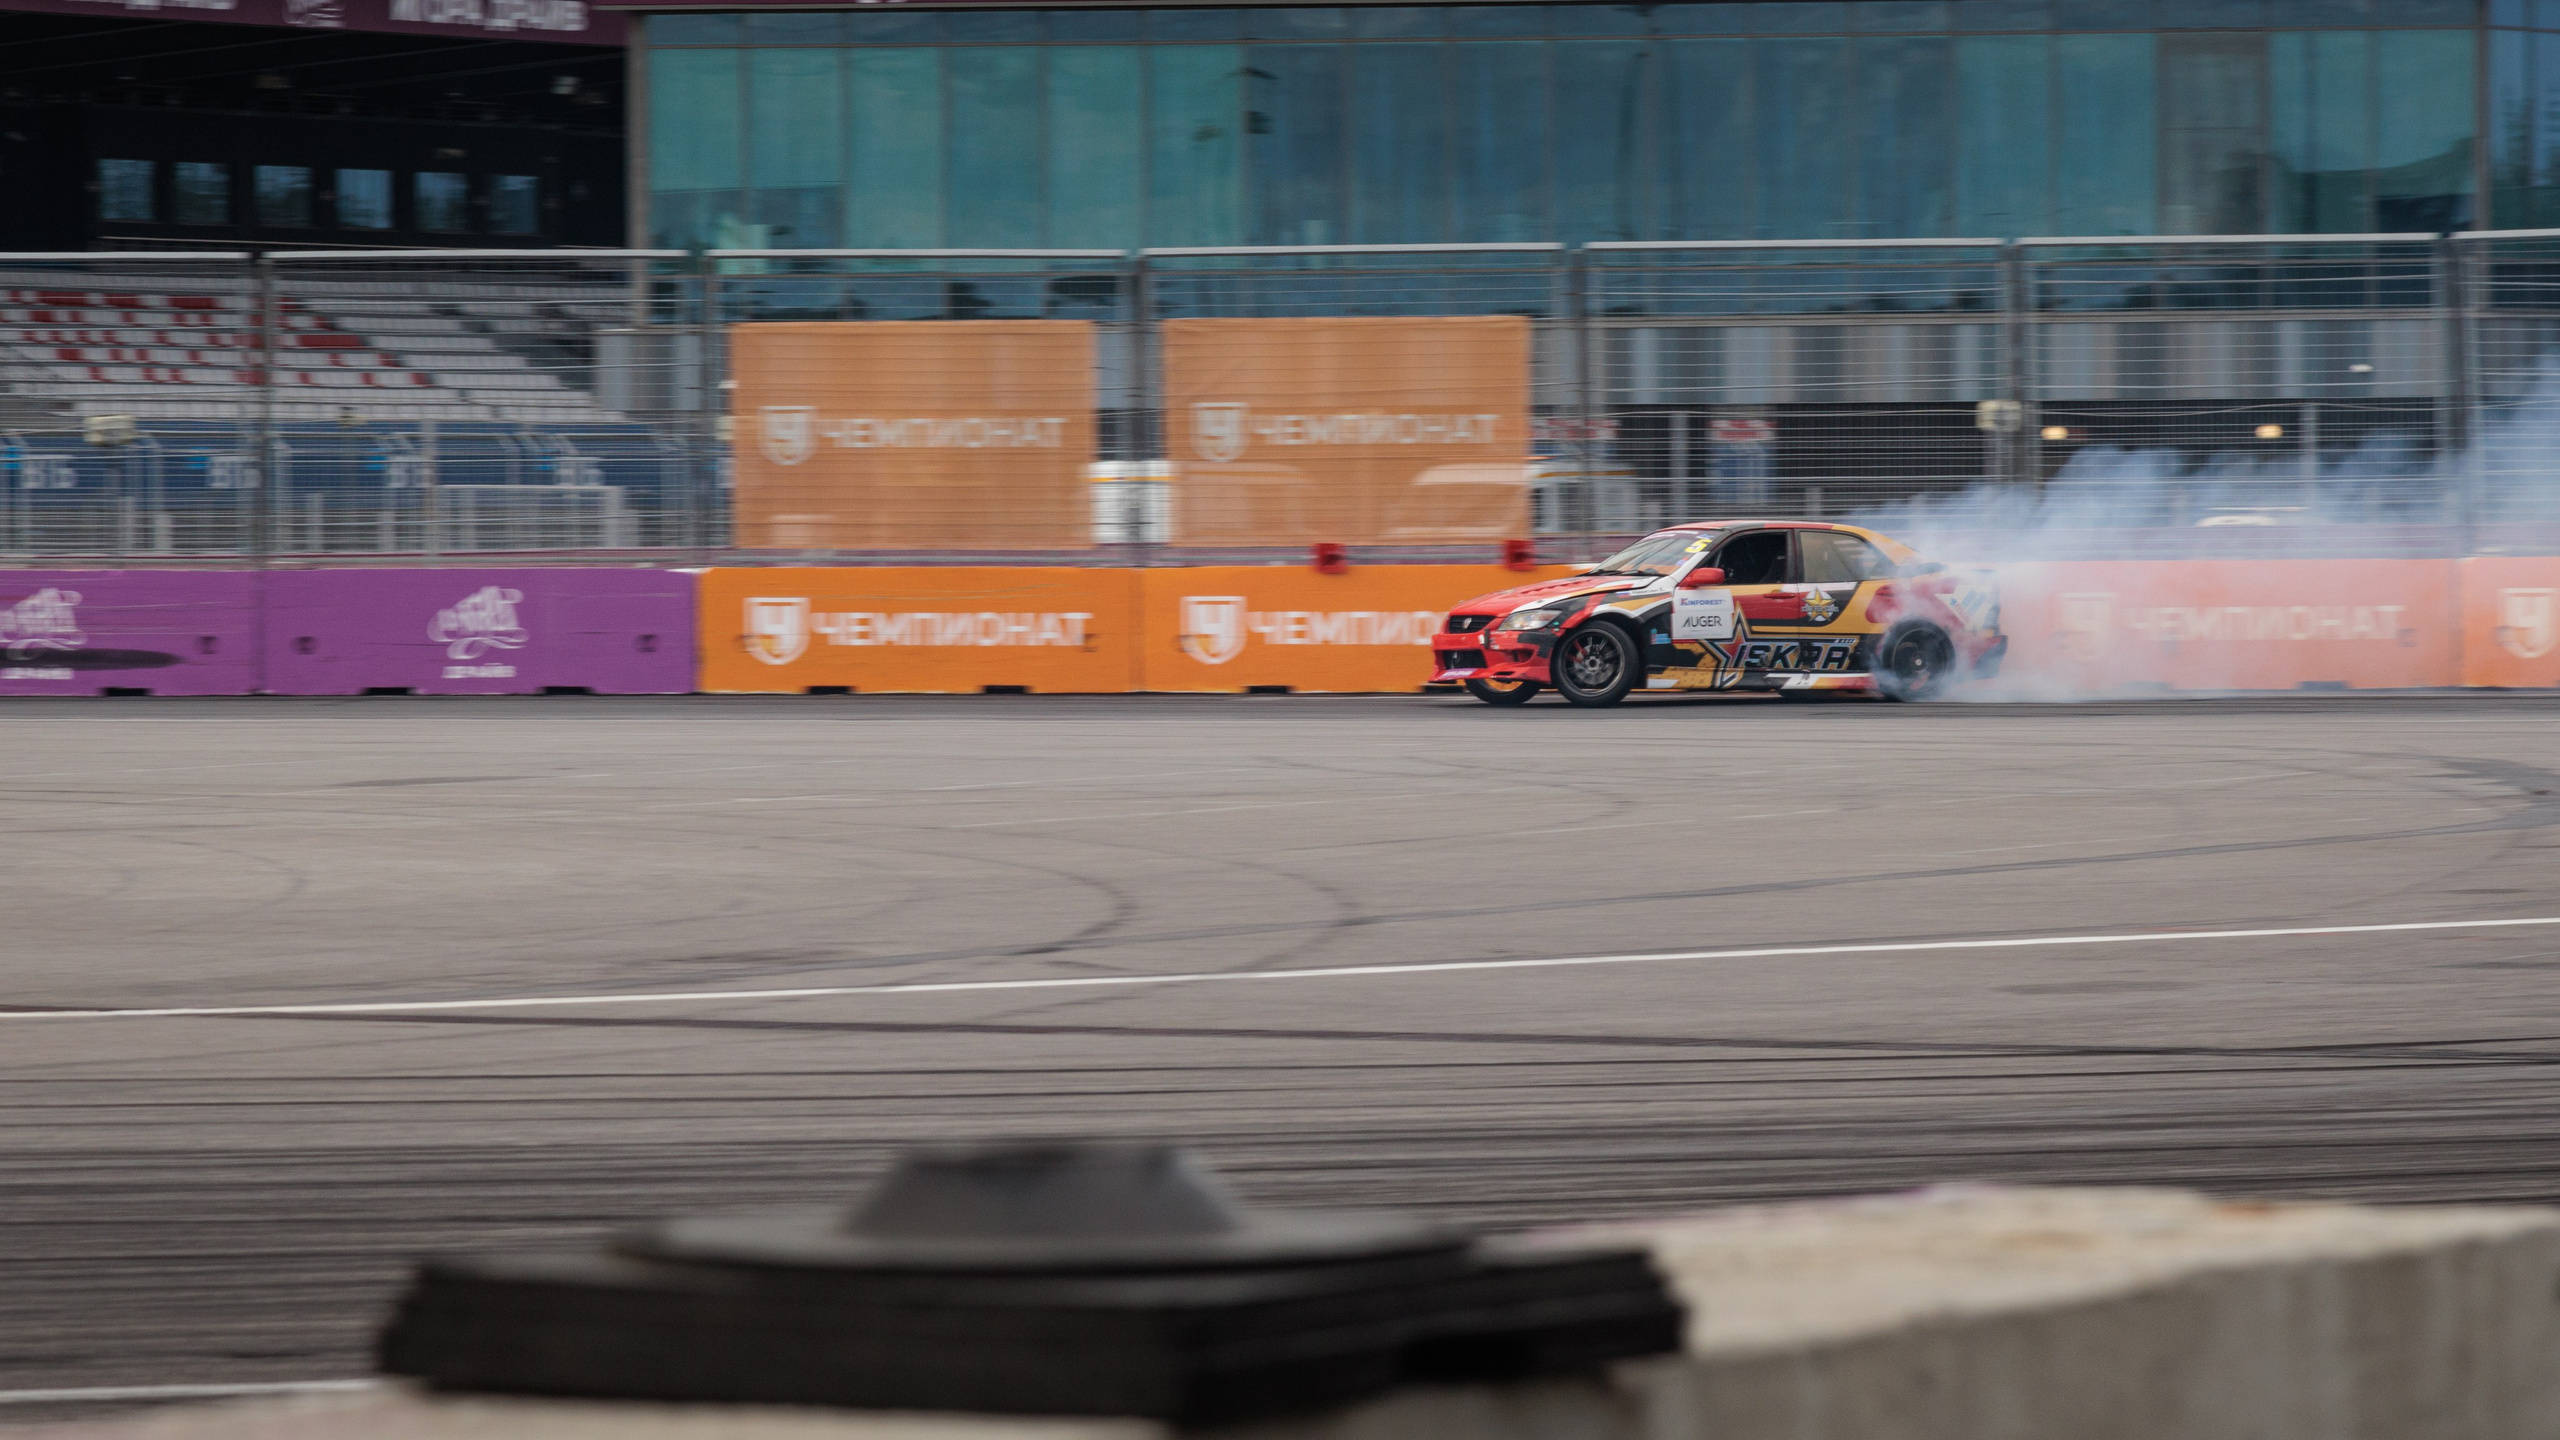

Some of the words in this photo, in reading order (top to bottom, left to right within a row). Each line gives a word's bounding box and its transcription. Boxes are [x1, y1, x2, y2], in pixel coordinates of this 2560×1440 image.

[818, 417, 1068, 448] ЧЕМПИОНАТ
[1249, 413, 1500, 445] ЧЕМПИОНАТ
[1680, 597, 1724, 606] KINFOREST
[811, 611, 1094, 647] ЧЕМПИОНАТ
[1682, 615, 1723, 628] AUGER
[2121, 605, 2407, 640] ЧЕМПИОНАТ
[1731, 642, 1852, 670] ISKRA
